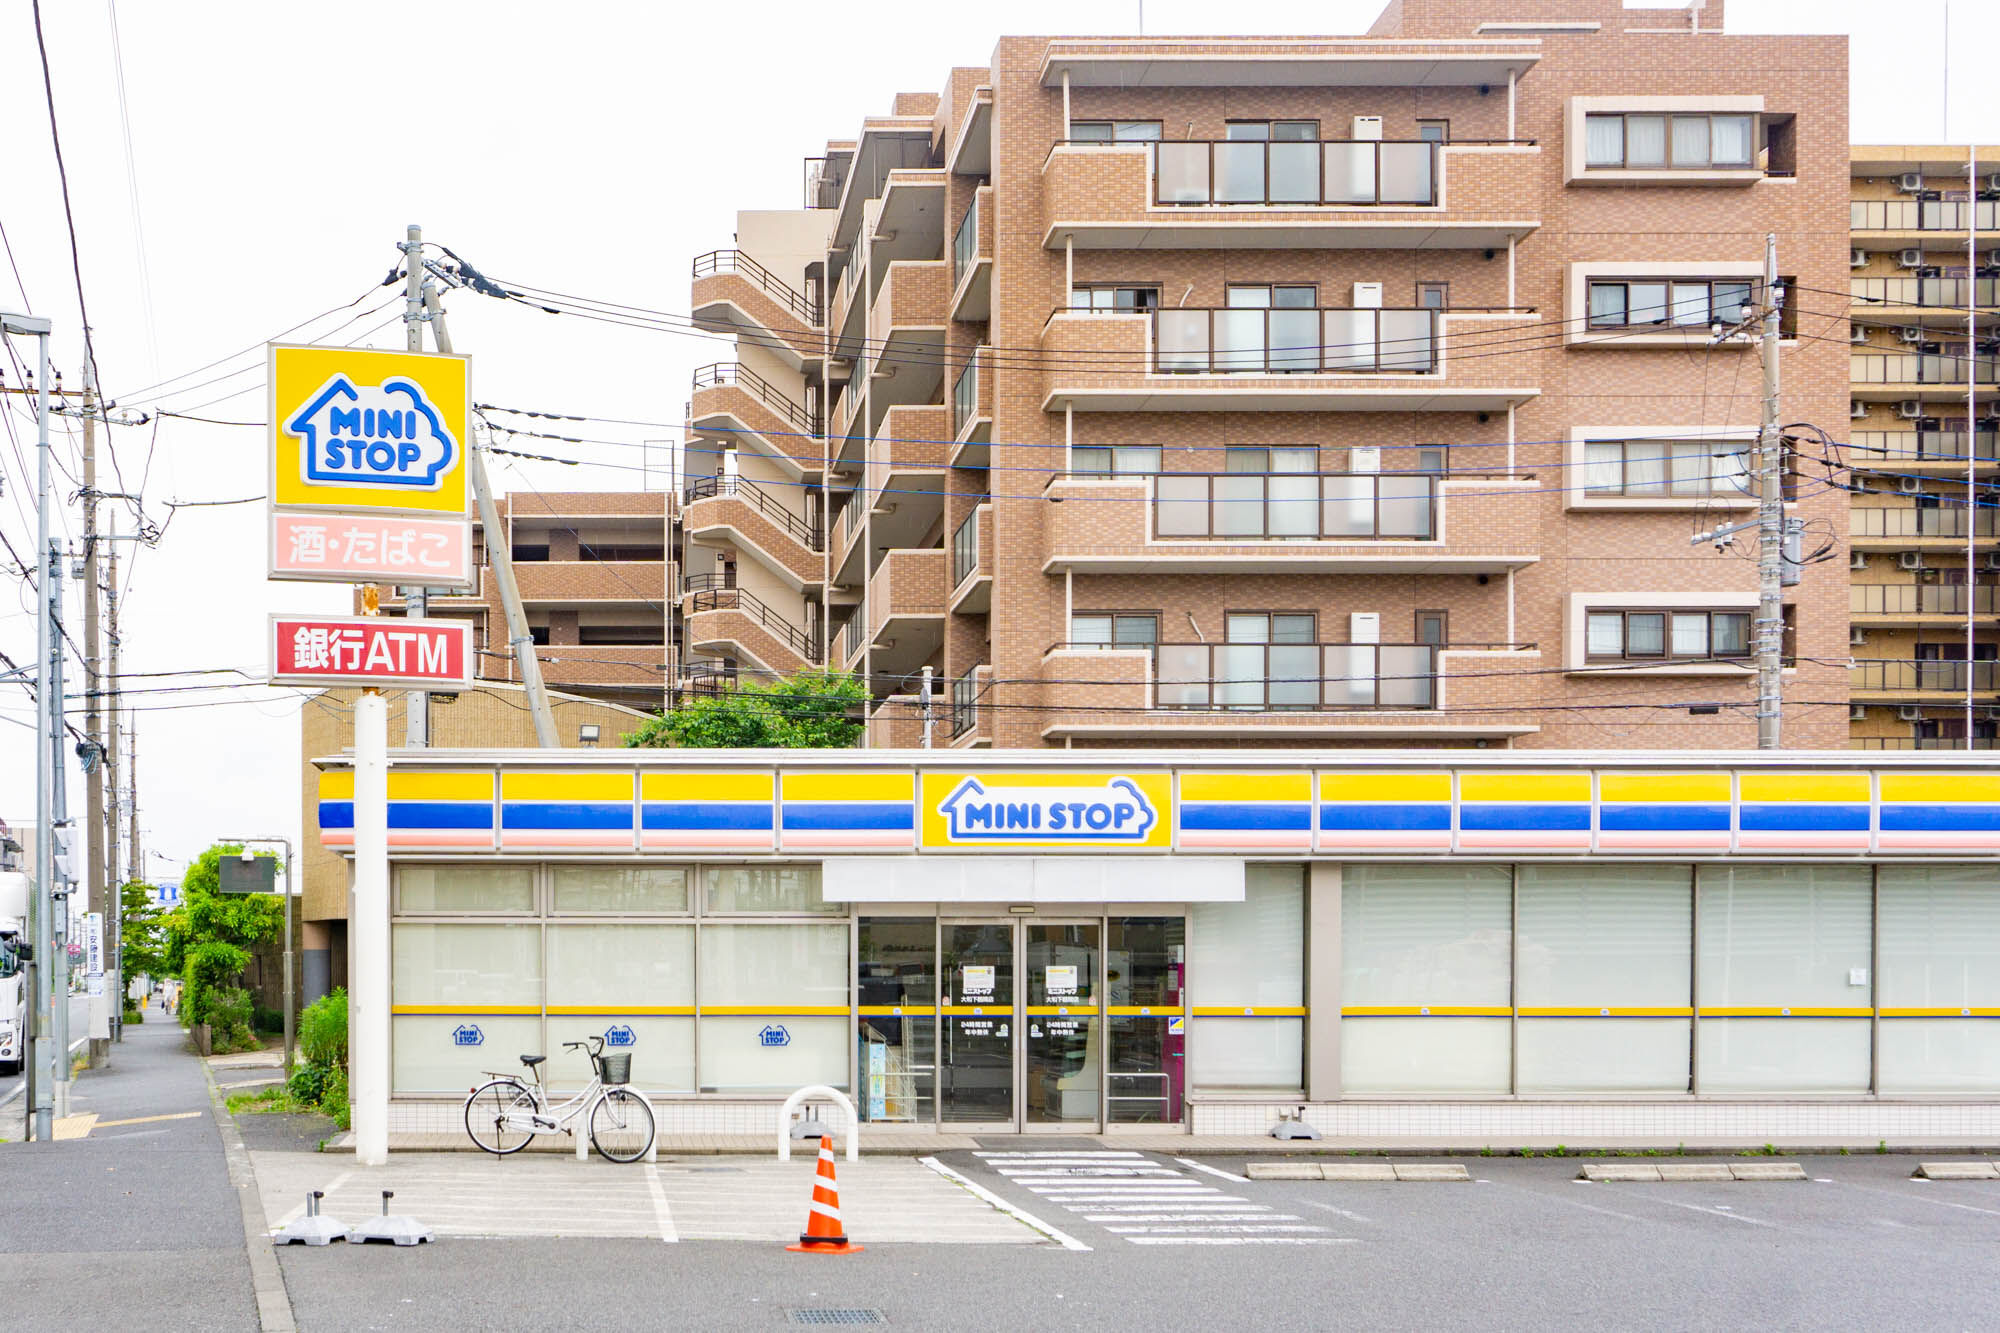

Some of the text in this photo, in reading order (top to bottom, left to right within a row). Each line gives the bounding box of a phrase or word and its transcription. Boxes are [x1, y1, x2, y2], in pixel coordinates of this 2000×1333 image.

[330, 405, 416, 440] MINI
[325, 438, 421, 472] STOP
[289, 524, 451, 568] 酒・たばこ
[294, 627, 448, 675] 銀行ATM
[965, 803, 1135, 830] MINI STOP
